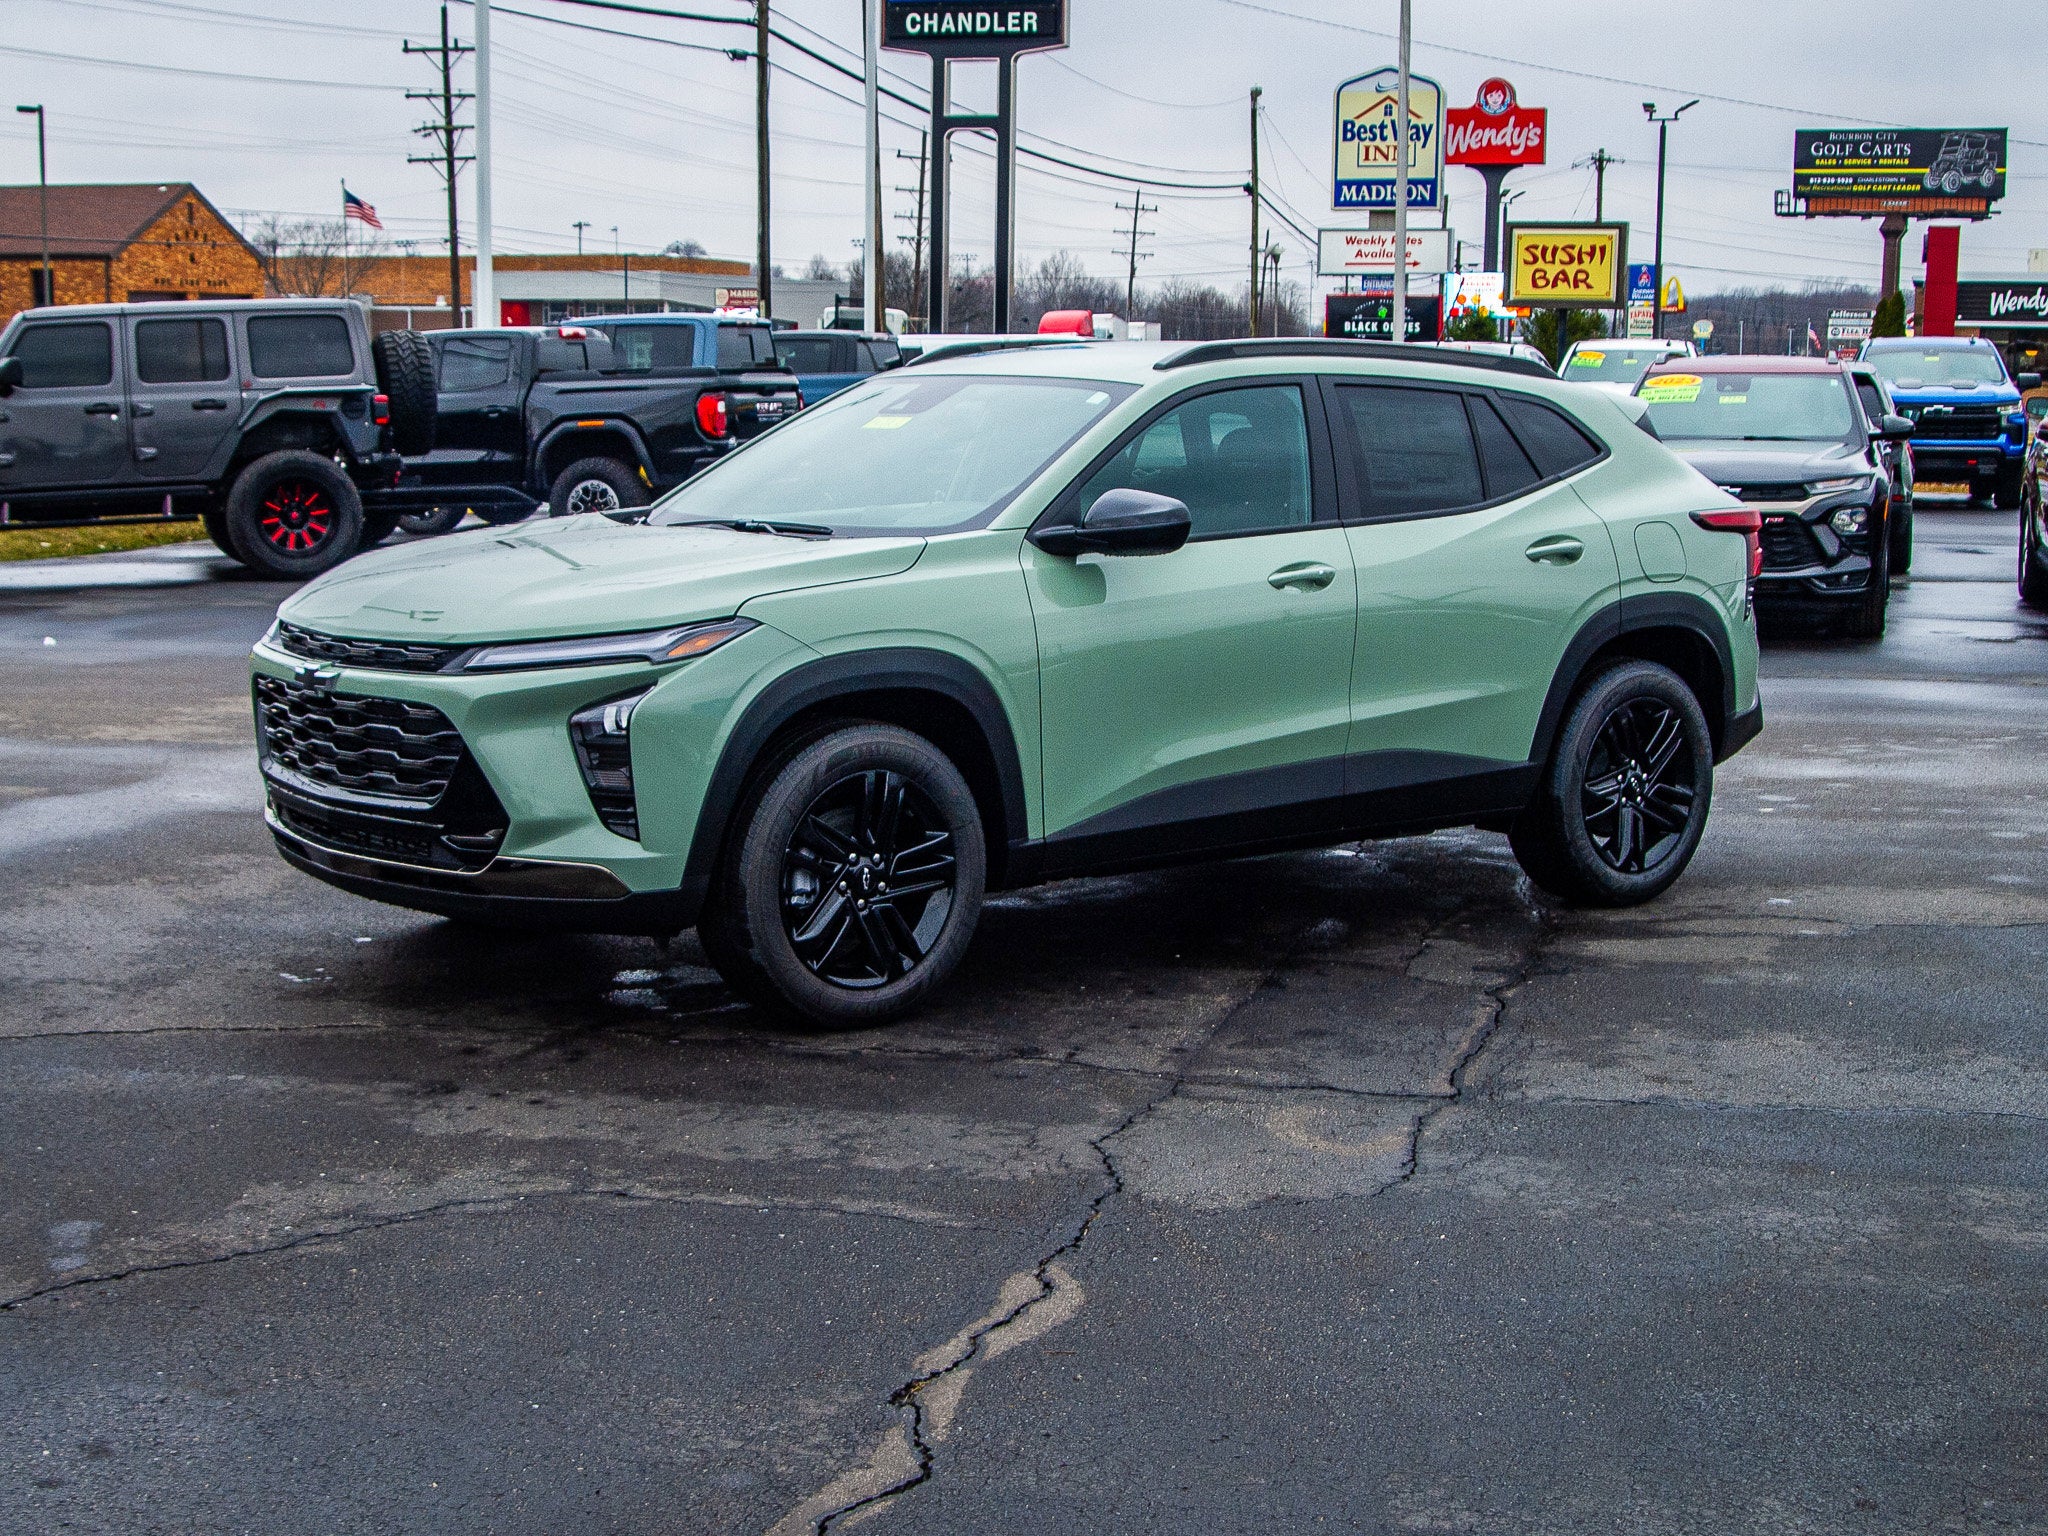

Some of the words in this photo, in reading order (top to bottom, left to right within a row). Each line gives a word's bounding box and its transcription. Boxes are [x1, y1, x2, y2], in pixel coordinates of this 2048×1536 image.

[905, 11, 1038, 34] CHANDLER
[1342, 119, 1388, 142] Best
[1446, 117, 1541, 156] Wendy's
[1875, 131, 1899, 141] CITY
[1811, 141, 1854, 156] GOLF
[1859, 141, 1912, 156] CARTS
[1344, 235, 1388, 247] Weekly
[1391, 235, 1423, 246] Rtes
[1354, 249, 1412, 259] Availae
[1522, 243, 1607, 266] SUSHI
[1531, 268, 1595, 291] BAR
[1344, 320, 1379, 333] BLACK
